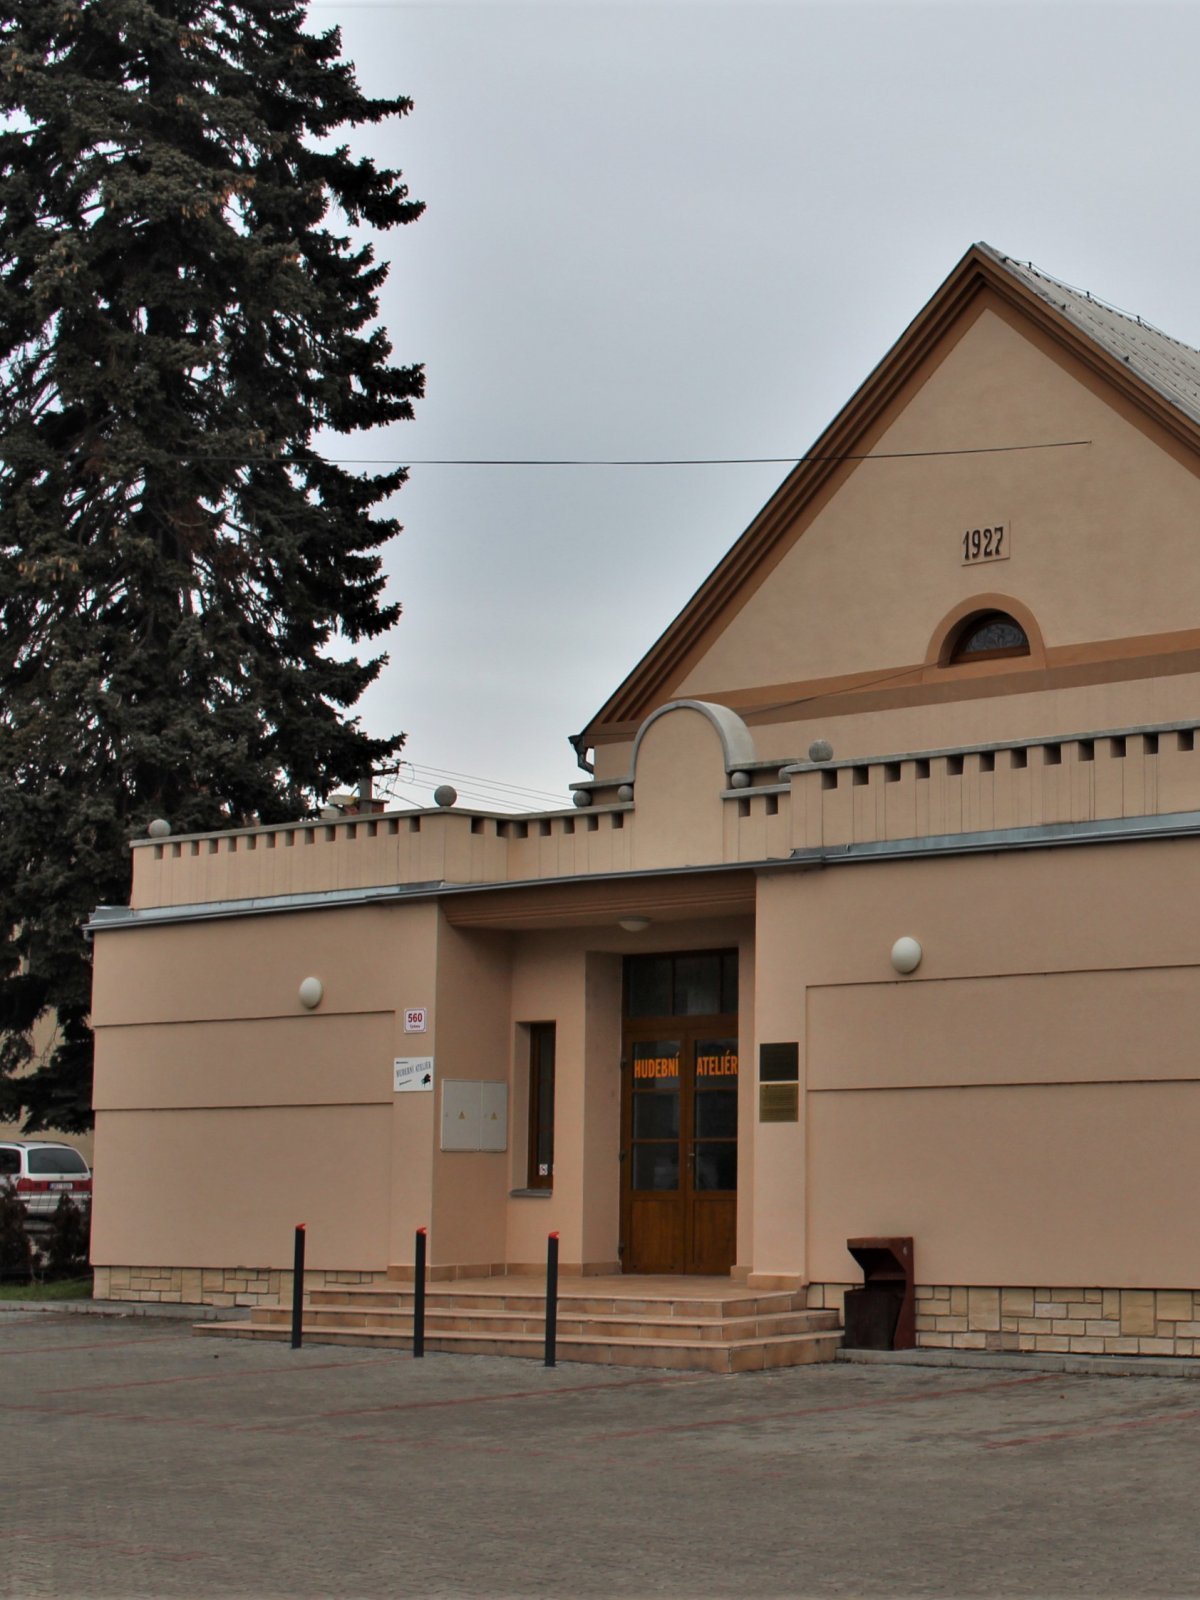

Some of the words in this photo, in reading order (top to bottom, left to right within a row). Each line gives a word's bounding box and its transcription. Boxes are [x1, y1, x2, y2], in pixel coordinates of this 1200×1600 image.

[962, 526, 1004, 560] 1927
[408, 1013, 422, 1023] 560
[634, 1052, 680, 1078] HUDEBNÍ
[696, 1049, 738, 1076] ATELIÉR
